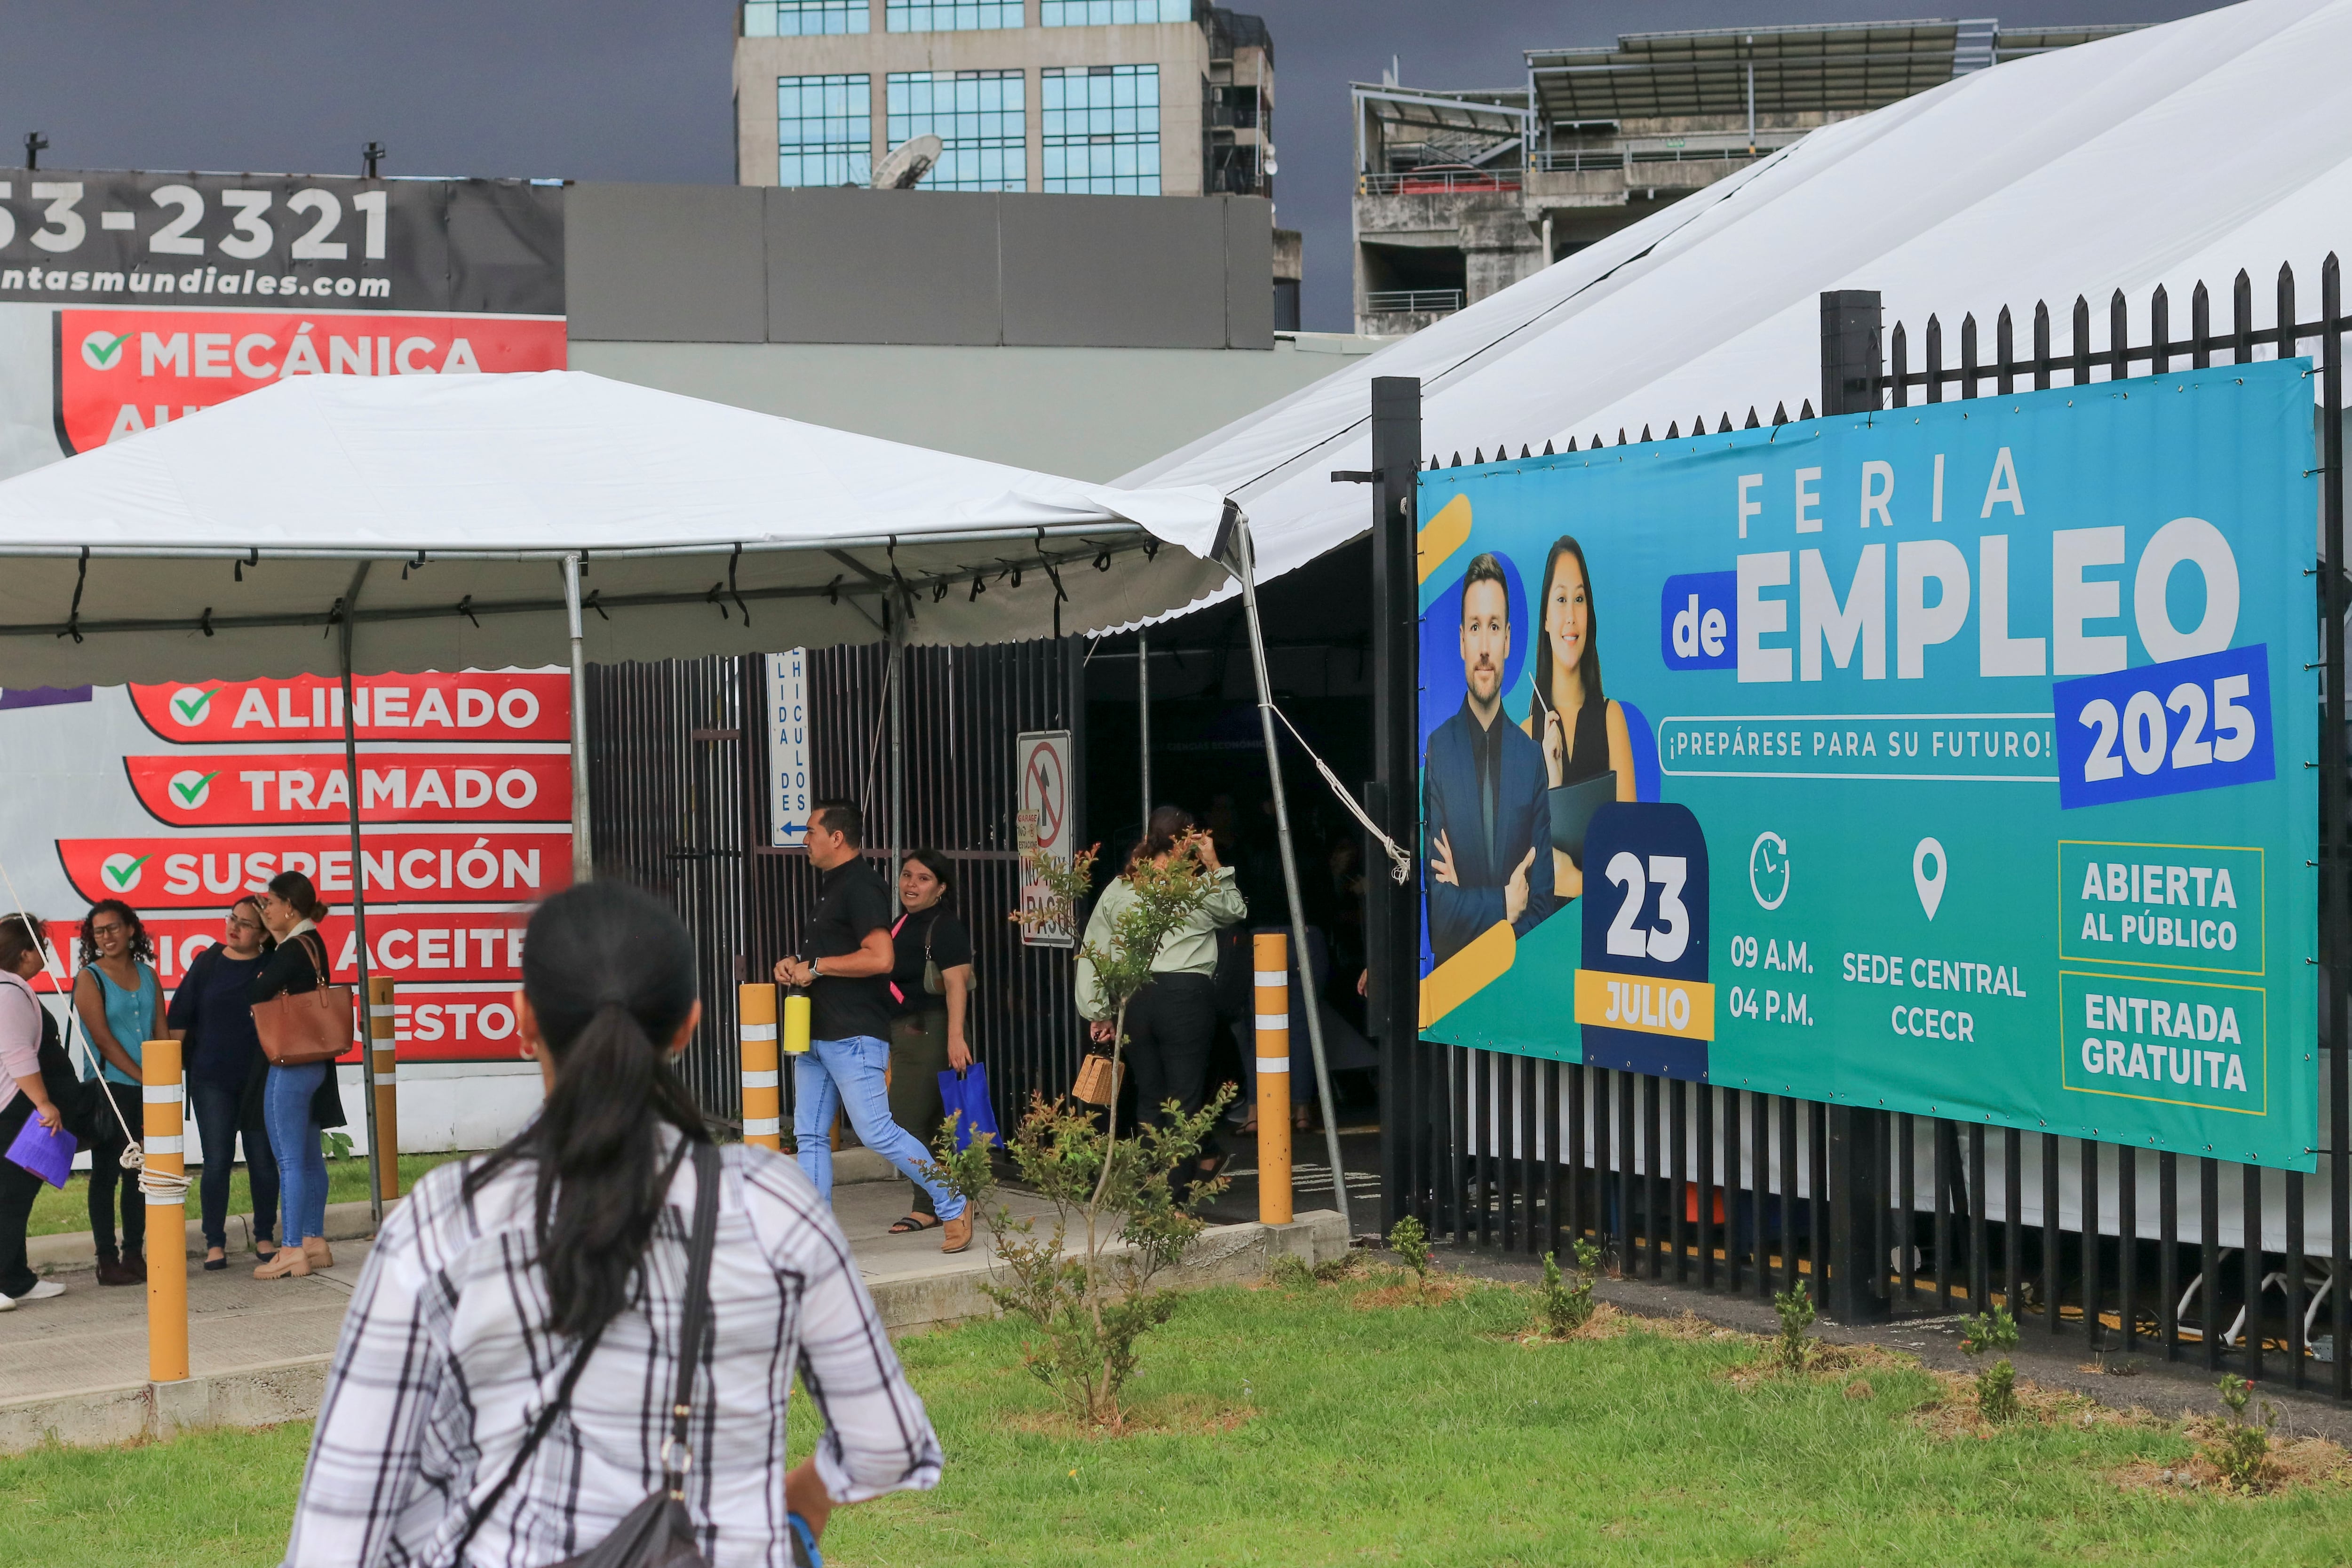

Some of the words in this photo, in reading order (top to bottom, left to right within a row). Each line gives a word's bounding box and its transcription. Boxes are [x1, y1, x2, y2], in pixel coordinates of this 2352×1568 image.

[0, 181, 387, 260] 3-2321
[1, 266, 391, 298] ntasmundiales.com
[140, 321, 482, 379] MECÁNICA
[1737, 446, 2026, 539] FERIA
[1671, 594, 1727, 658] de
[1736, 516, 2240, 683] EMPLEO
[231, 687, 540, 729] ALINEADO
[777, 652, 788, 745] LIDA
[1669, 725, 1803, 760] ¡PREPÁRESE
[1813, 731, 1877, 757] PARA
[1888, 731, 1920, 758] SU
[1932, 731, 2052, 758] FUTURO!
[2077, 673, 2257, 783] 2025
[239, 768, 538, 811] TRAMADO
[781, 772, 790, 811] DE
[1018, 826, 1026, 836] NO
[163, 837, 540, 895] SUSPENCIÓN
[2081, 862, 2237, 909] ABIERTA
[1605, 851, 1690, 963] 23
[2081, 912, 2114, 942] AL
[2122, 909, 2237, 951] PÚBLICO
[334, 928, 527, 971] ACEITE
[1731, 935, 1758, 969] 09
[1764, 939, 1814, 974] A.M.
[1843, 952, 1904, 986] SEDE
[1910, 957, 2026, 998] CENTRAL
[1605, 980, 1690, 1031] JULIO
[1729, 986, 1759, 1020] 04
[1765, 989, 1814, 1027] P.M.
[1891, 1005, 1974, 1043] CCECR
[2085, 993, 2241, 1045] ENTRADA
[2082, 1037, 2247, 1092] GRATUITA
